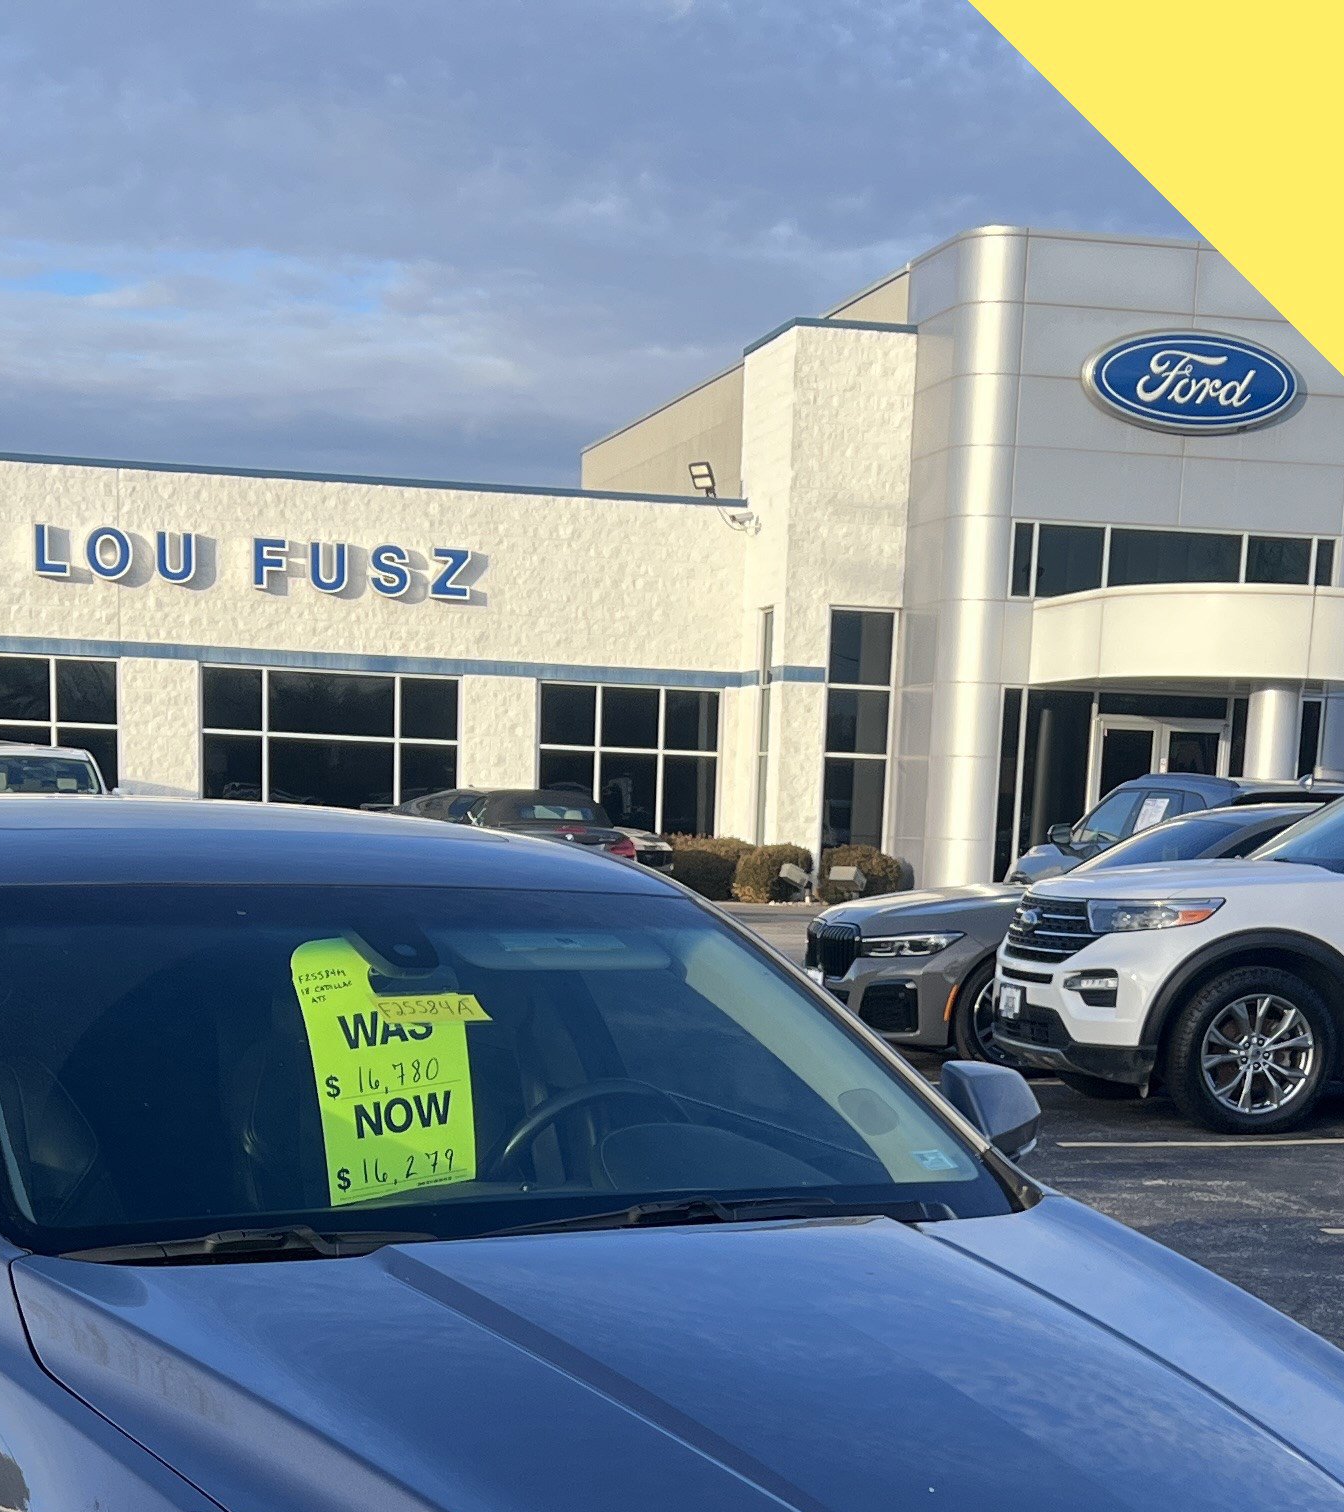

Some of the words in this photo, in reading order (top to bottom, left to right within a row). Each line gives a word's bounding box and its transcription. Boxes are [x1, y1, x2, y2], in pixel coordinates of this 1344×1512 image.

[1135, 349, 1254, 408] Ford
[33, 523, 197, 584] LOU
[252, 537, 472, 601] FUSZ
[337, 1011, 433, 1050] WAS
[325, 1075, 341, 1100] $
[358, 1057, 439, 1094] 16,780
[353, 1090, 451, 1139] NOW
[337, 1166, 351, 1192] $
[363, 1149, 454, 1185] 16,279
